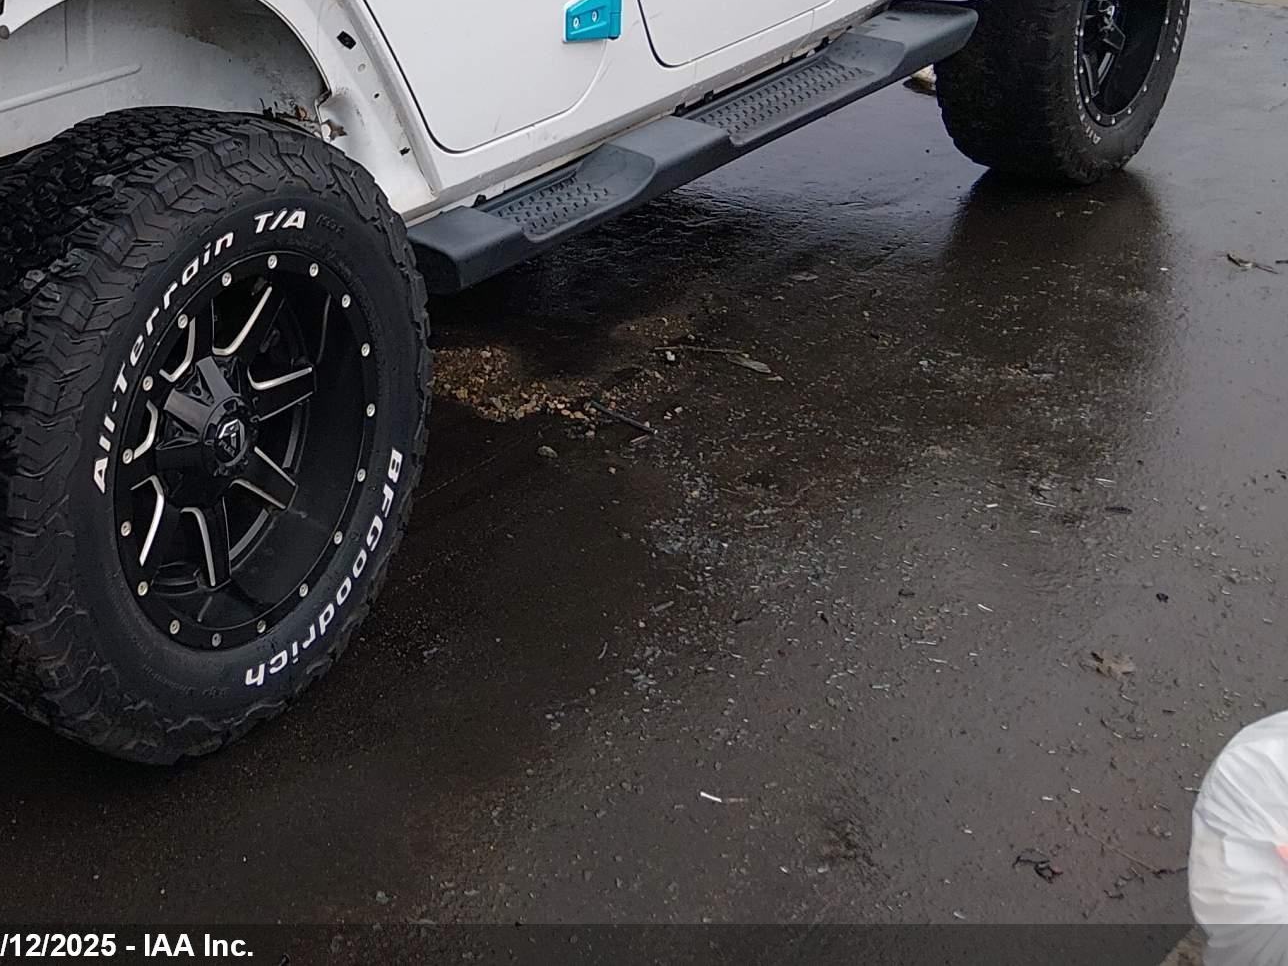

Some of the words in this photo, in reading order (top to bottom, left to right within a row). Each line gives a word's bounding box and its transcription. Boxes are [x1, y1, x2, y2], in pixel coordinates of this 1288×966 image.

[93, 231, 235, 494] All-Terrain
[254, 209, 307, 234] T/A
[244, 446, 404, 687] BFGoodrich
